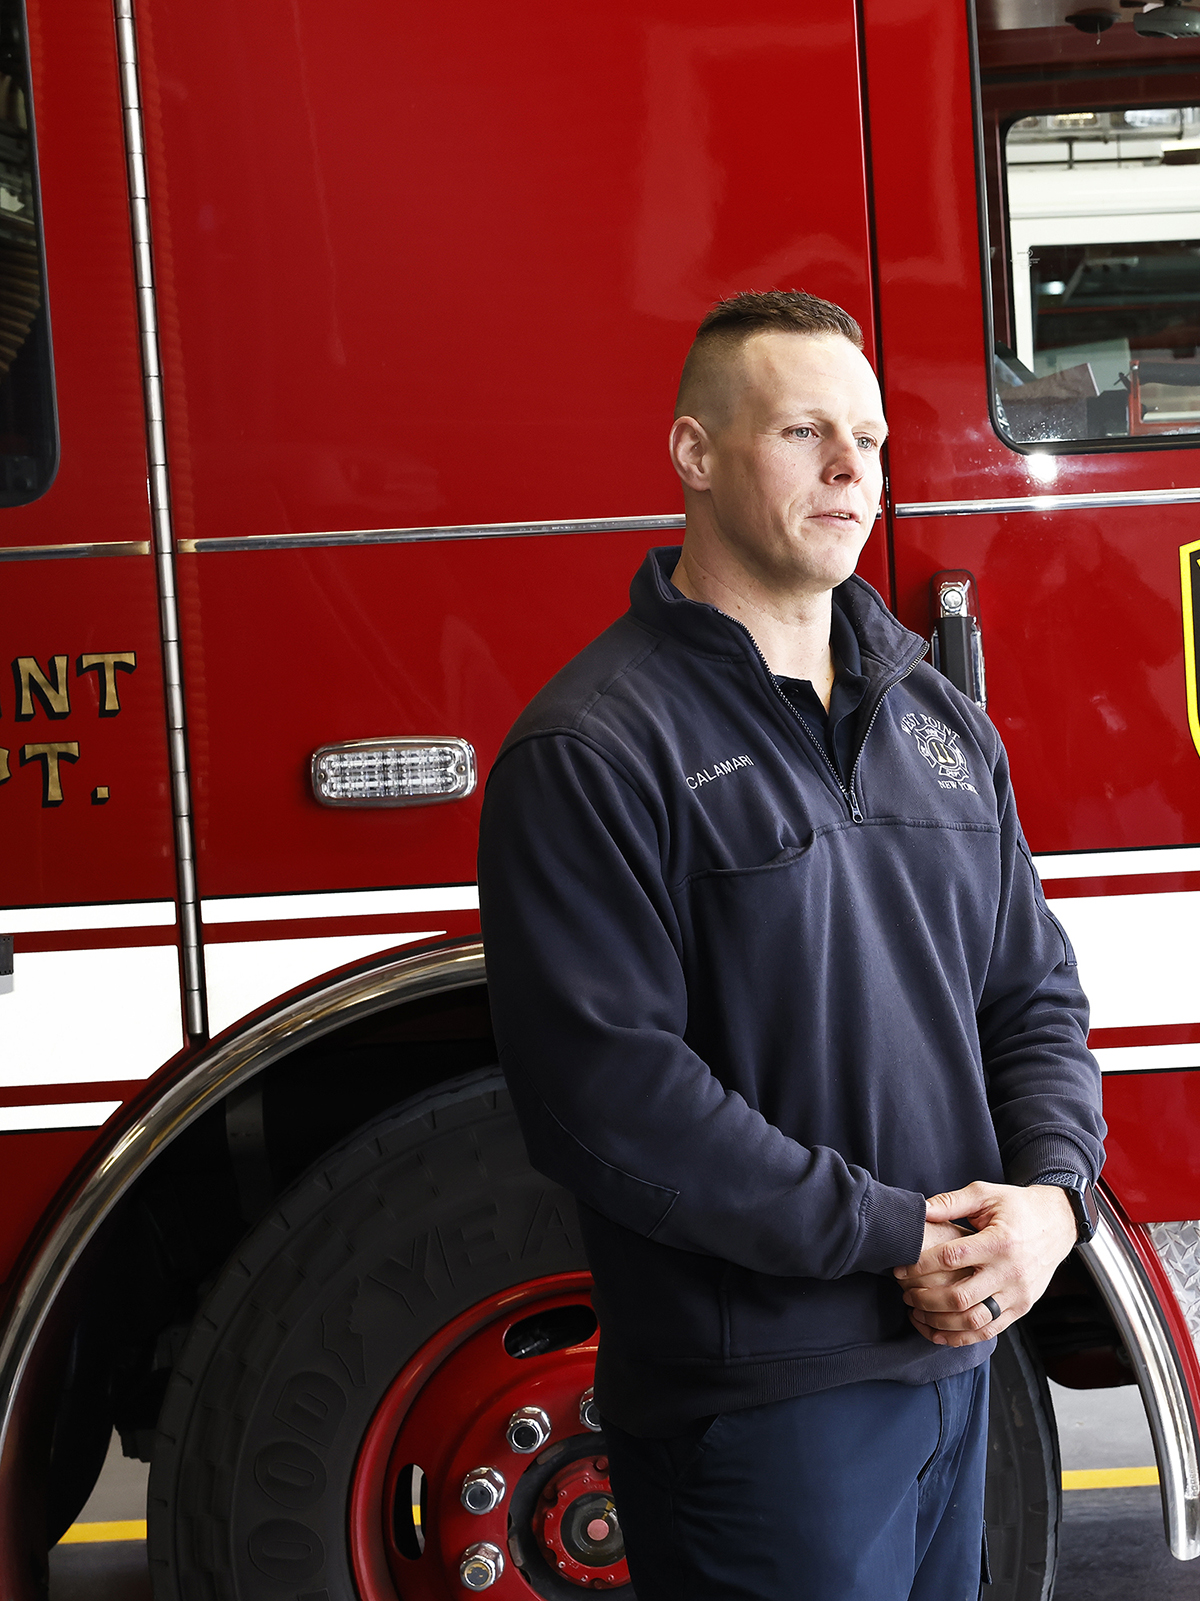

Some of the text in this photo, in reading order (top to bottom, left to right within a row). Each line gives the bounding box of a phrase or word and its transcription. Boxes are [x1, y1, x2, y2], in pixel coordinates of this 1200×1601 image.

[0, 651, 137, 722] NT
[920, 713, 960, 740] POINT
[686, 754, 754, 789] CALAMARI
[938, 780, 957, 789] NEW
